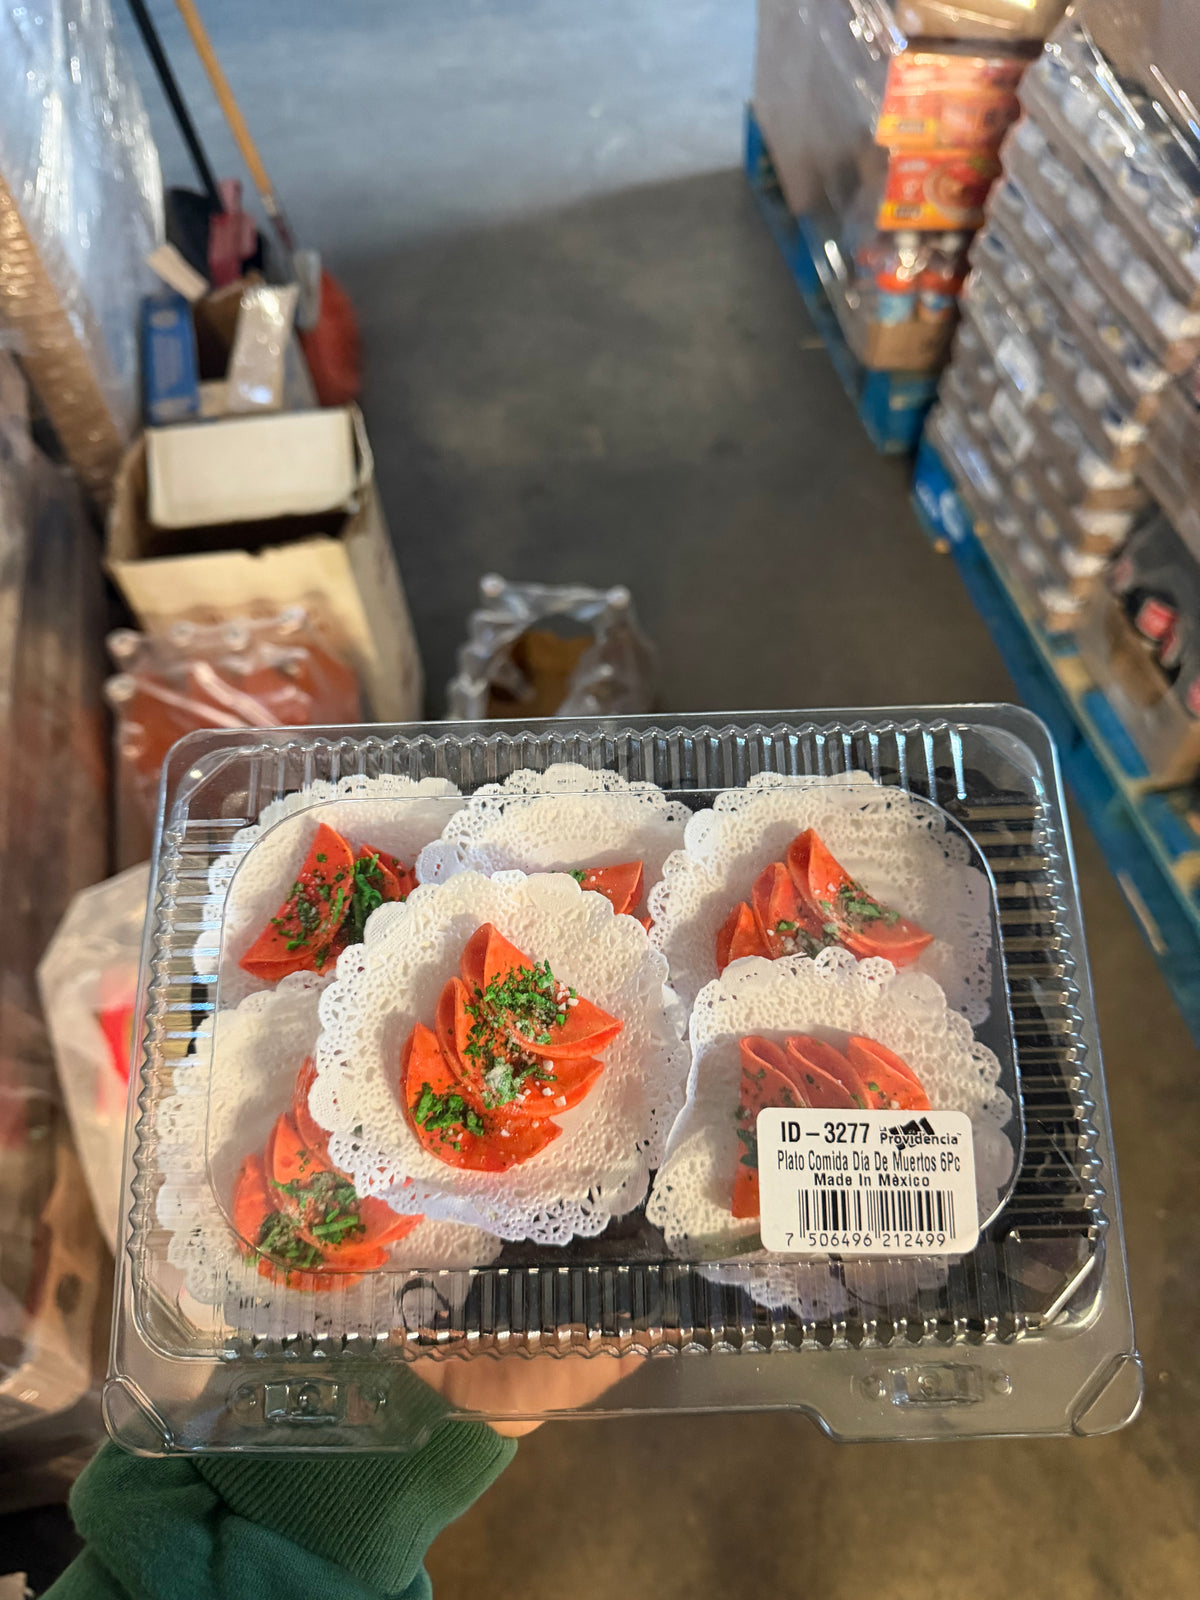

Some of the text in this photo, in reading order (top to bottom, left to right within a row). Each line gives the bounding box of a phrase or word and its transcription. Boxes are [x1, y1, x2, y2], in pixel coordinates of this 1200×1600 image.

[880, 1132, 958, 1145] Providencia
[777, 1150, 805, 1171] Plato
[808, 1150, 849, 1171] Comida
[874, 1151, 888, 1171] De
[892, 1151, 937, 1172] Muertos
[940, 1152, 961, 1172] 6Pc
[814, 1173, 852, 1186] Made
[859, 1173, 872, 1186] In
[785, 1233, 946, 1247] 7 506496 212499
